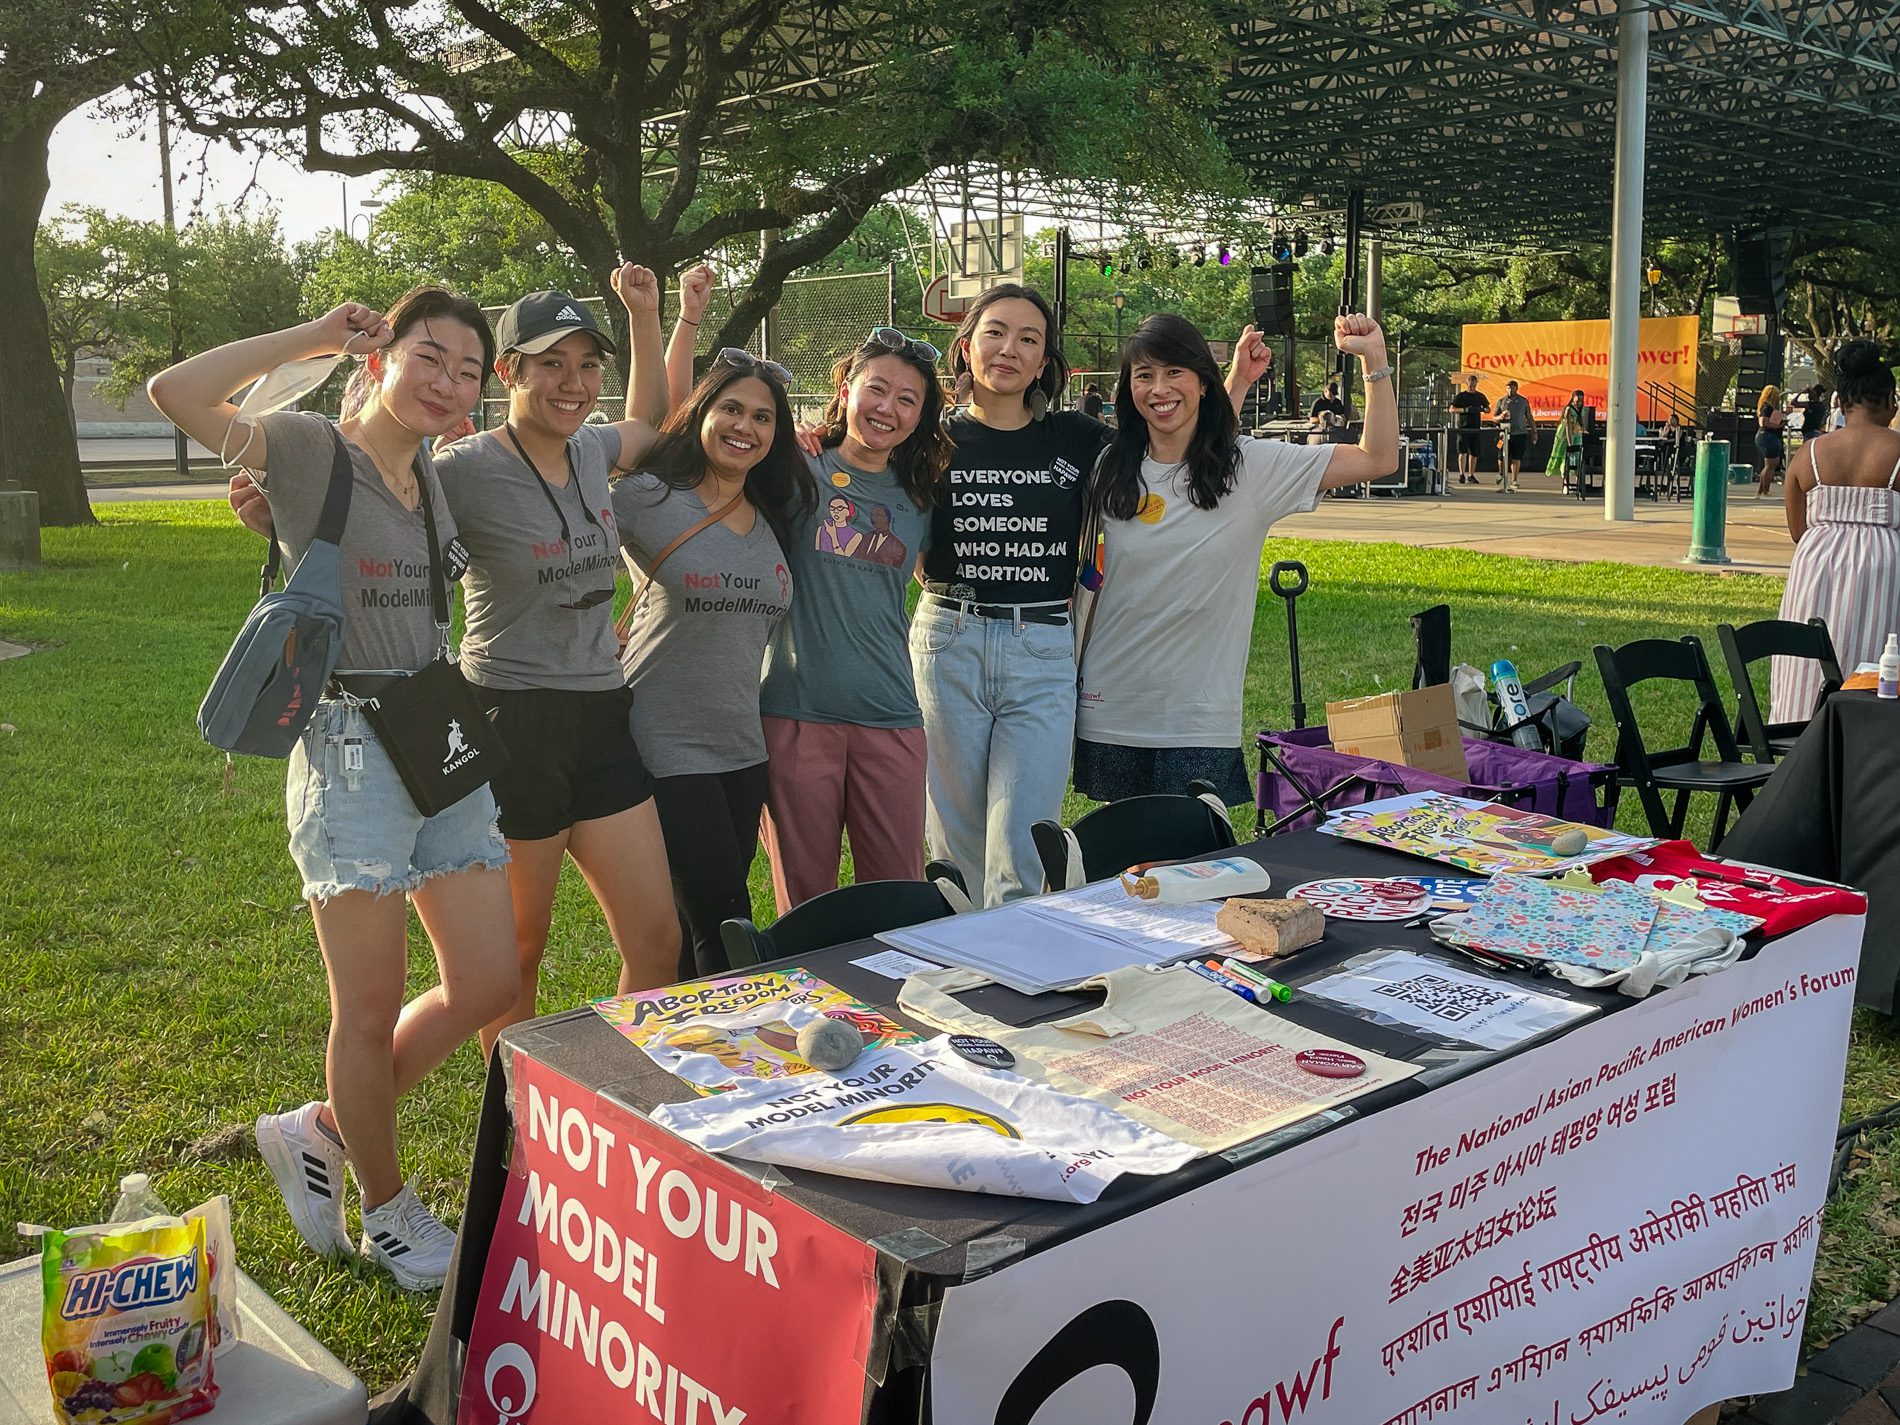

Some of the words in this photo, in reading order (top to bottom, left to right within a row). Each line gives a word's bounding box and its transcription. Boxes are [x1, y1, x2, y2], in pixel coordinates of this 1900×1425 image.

[555, 314, 582, 322] adidas
[1466, 352, 1519, 369] Grow
[1522, 347, 1608, 368] Abortion
[1638, 345, 1690, 365] ower!
[950, 470, 1052, 484] EVERYONE
[951, 492, 1014, 507] LOVES
[953, 516, 1048, 532] SOMEONE
[532, 534, 597, 560] Notour
[953, 542, 1000, 557] WHO
[1004, 542, 1045, 557] HAD
[1046, 541, 1067, 556] AN
[683, 571, 761, 590] NotYour
[955, 562, 1050, 582] ABORTION.
[442, 748, 480, 776] KANGOL
[1367, 811, 1433, 843] ABORTION
[631, 978, 776, 1026] ABORTION
[1121, 1089, 1151, 1103] NOT
[1150, 1076, 1189, 1094] YOUR
[1187, 1062, 1231, 1079] MODEL
[1228, 1043, 1284, 1065] MINORITY
[1301, 1059, 1340, 1067] WOMAN
[1340, 1062, 1363, 1070] AAPI
[1414, 1144, 1451, 1177] The
[1455, 1093, 1544, 1158] National
[1542, 1075, 1593, 1114] Asian
[1596, 1045, 1648, 1088] Pacific
[1647, 1016, 1727, 1062] American
[1730, 979, 1798, 1027] Women's
[1799, 965, 1856, 997] Forum
[744, 1101, 836, 1130] MODEL
[834, 1059, 947, 1108] MINORIT
[766, 1090, 823, 1109] NOT
[823, 1063, 899, 1092] YOUR
[1400, 1190, 1444, 1239] 전국
[1447, 1167, 1490, 1210] 미주
[1493, 1135, 1548, 1188] 아시아
[1550, 1106, 1604, 1156] 태평양
[1606, 1088, 1640, 1129] 여성
[1643, 1072, 1677, 1113] 포럼
[528, 1083, 615, 1188] NOT
[627, 1142, 781, 1290] YOUR
[1770, 1162, 1797, 1195] मंच
[517, 1169, 666, 1326] MODEL
[1388, 1185, 1557, 1304] 全美亚太妇女论坛
[61, 1246, 198, 1321] HI-CHEW
[89, 1335, 128, 1349] Intensely
[127, 1329, 168, 1344] Chewy
[168, 1322, 190, 1336] Candy
[104, 1322, 149, 1338] Immensely
[149, 1316, 181, 1331] Fruity
